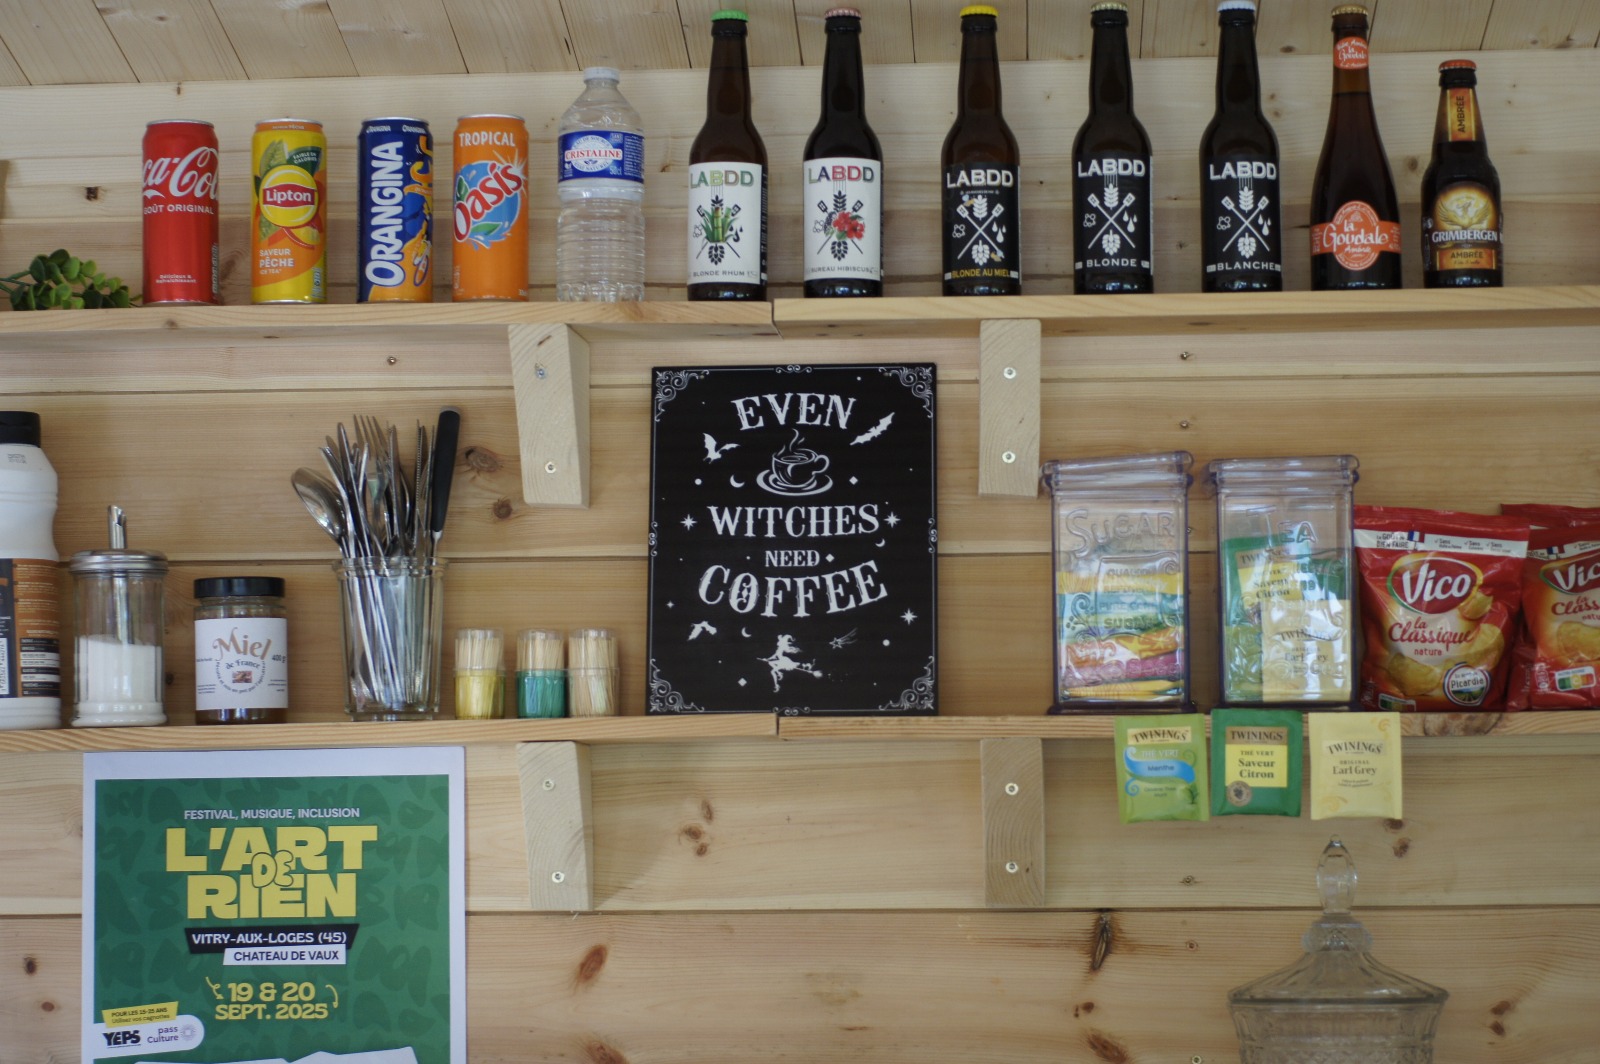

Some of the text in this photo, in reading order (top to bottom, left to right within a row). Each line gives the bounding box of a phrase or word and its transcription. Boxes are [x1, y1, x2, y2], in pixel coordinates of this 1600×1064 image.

[1456, 96, 1465, 133] AMBRÉE
[459, 131, 516, 147] TROPICAL
[566, 149, 622, 160] CRISTALINE
[808, 165, 874, 184] LABDD
[1078, 158, 1146, 178] LABDD
[1210, 162, 1277, 180] LABDD
[690, 170, 754, 189] LABDD
[946, 169, 1014, 188] LABDD
[266, 189, 312, 204] Lipton
[454, 163, 523, 242] Oasis
[167, 204, 214, 215] ORIGINAL
[366, 141, 404, 286] ORANGINA
[1344, 220, 1354, 232] la
[1323, 224, 1389, 252] Goudale
[1432, 230, 1498, 242] GRIMBERGEN
[260, 248, 292, 257] SAVEUR
[1450, 250, 1484, 258] AMBRÉE
[260, 256, 295, 268] PÊCHE
[1086, 258, 1137, 268] BLONDE
[1218, 261, 1276, 271] BLANCHE
[952, 269, 980, 278] BLONDE
[731, 393, 856, 430] EVEN
[707, 504, 880, 538] WITCHES
[764, 550, 820, 568] NEED
[698, 560, 888, 618] COFFEE
[1402, 561, 1472, 604] Vico
[1256, 588, 1290, 598] Citron
[1414, 617, 1427, 629] la
[212, 627, 272, 660] Miel
[1388, 621, 1474, 652] Classique
[1451, 678, 1484, 688] Picardie
[1133, 729, 1187, 742] TWININGS
[1231, 730, 1284, 740] TWININGS
[1326, 741, 1383, 754] TWININGS
[1238, 758, 1276, 768] Saveur
[1239, 769, 1274, 778] Citron
[1332, 766, 1378, 776] Earl Grey
[184, 808, 360, 820] FESTIVAL, MUSIQUE, INCLUSION
[166, 825, 378, 872] L'ART
[251, 850, 294, 888] DE
[187, 873, 356, 920] RIEN
[192, 932, 347, 944] VITRY-AUX-LOGES (45)
[234, 950, 339, 962] CHATEAU DE VAUX
[228, 982, 316, 1002] 19 & 20
[214, 1004, 328, 1020] SEPT. 2025
[158, 1026, 178, 1035] pass
[102, 1030, 141, 1046] YEPS
[147, 1035, 178, 1044] Culture
